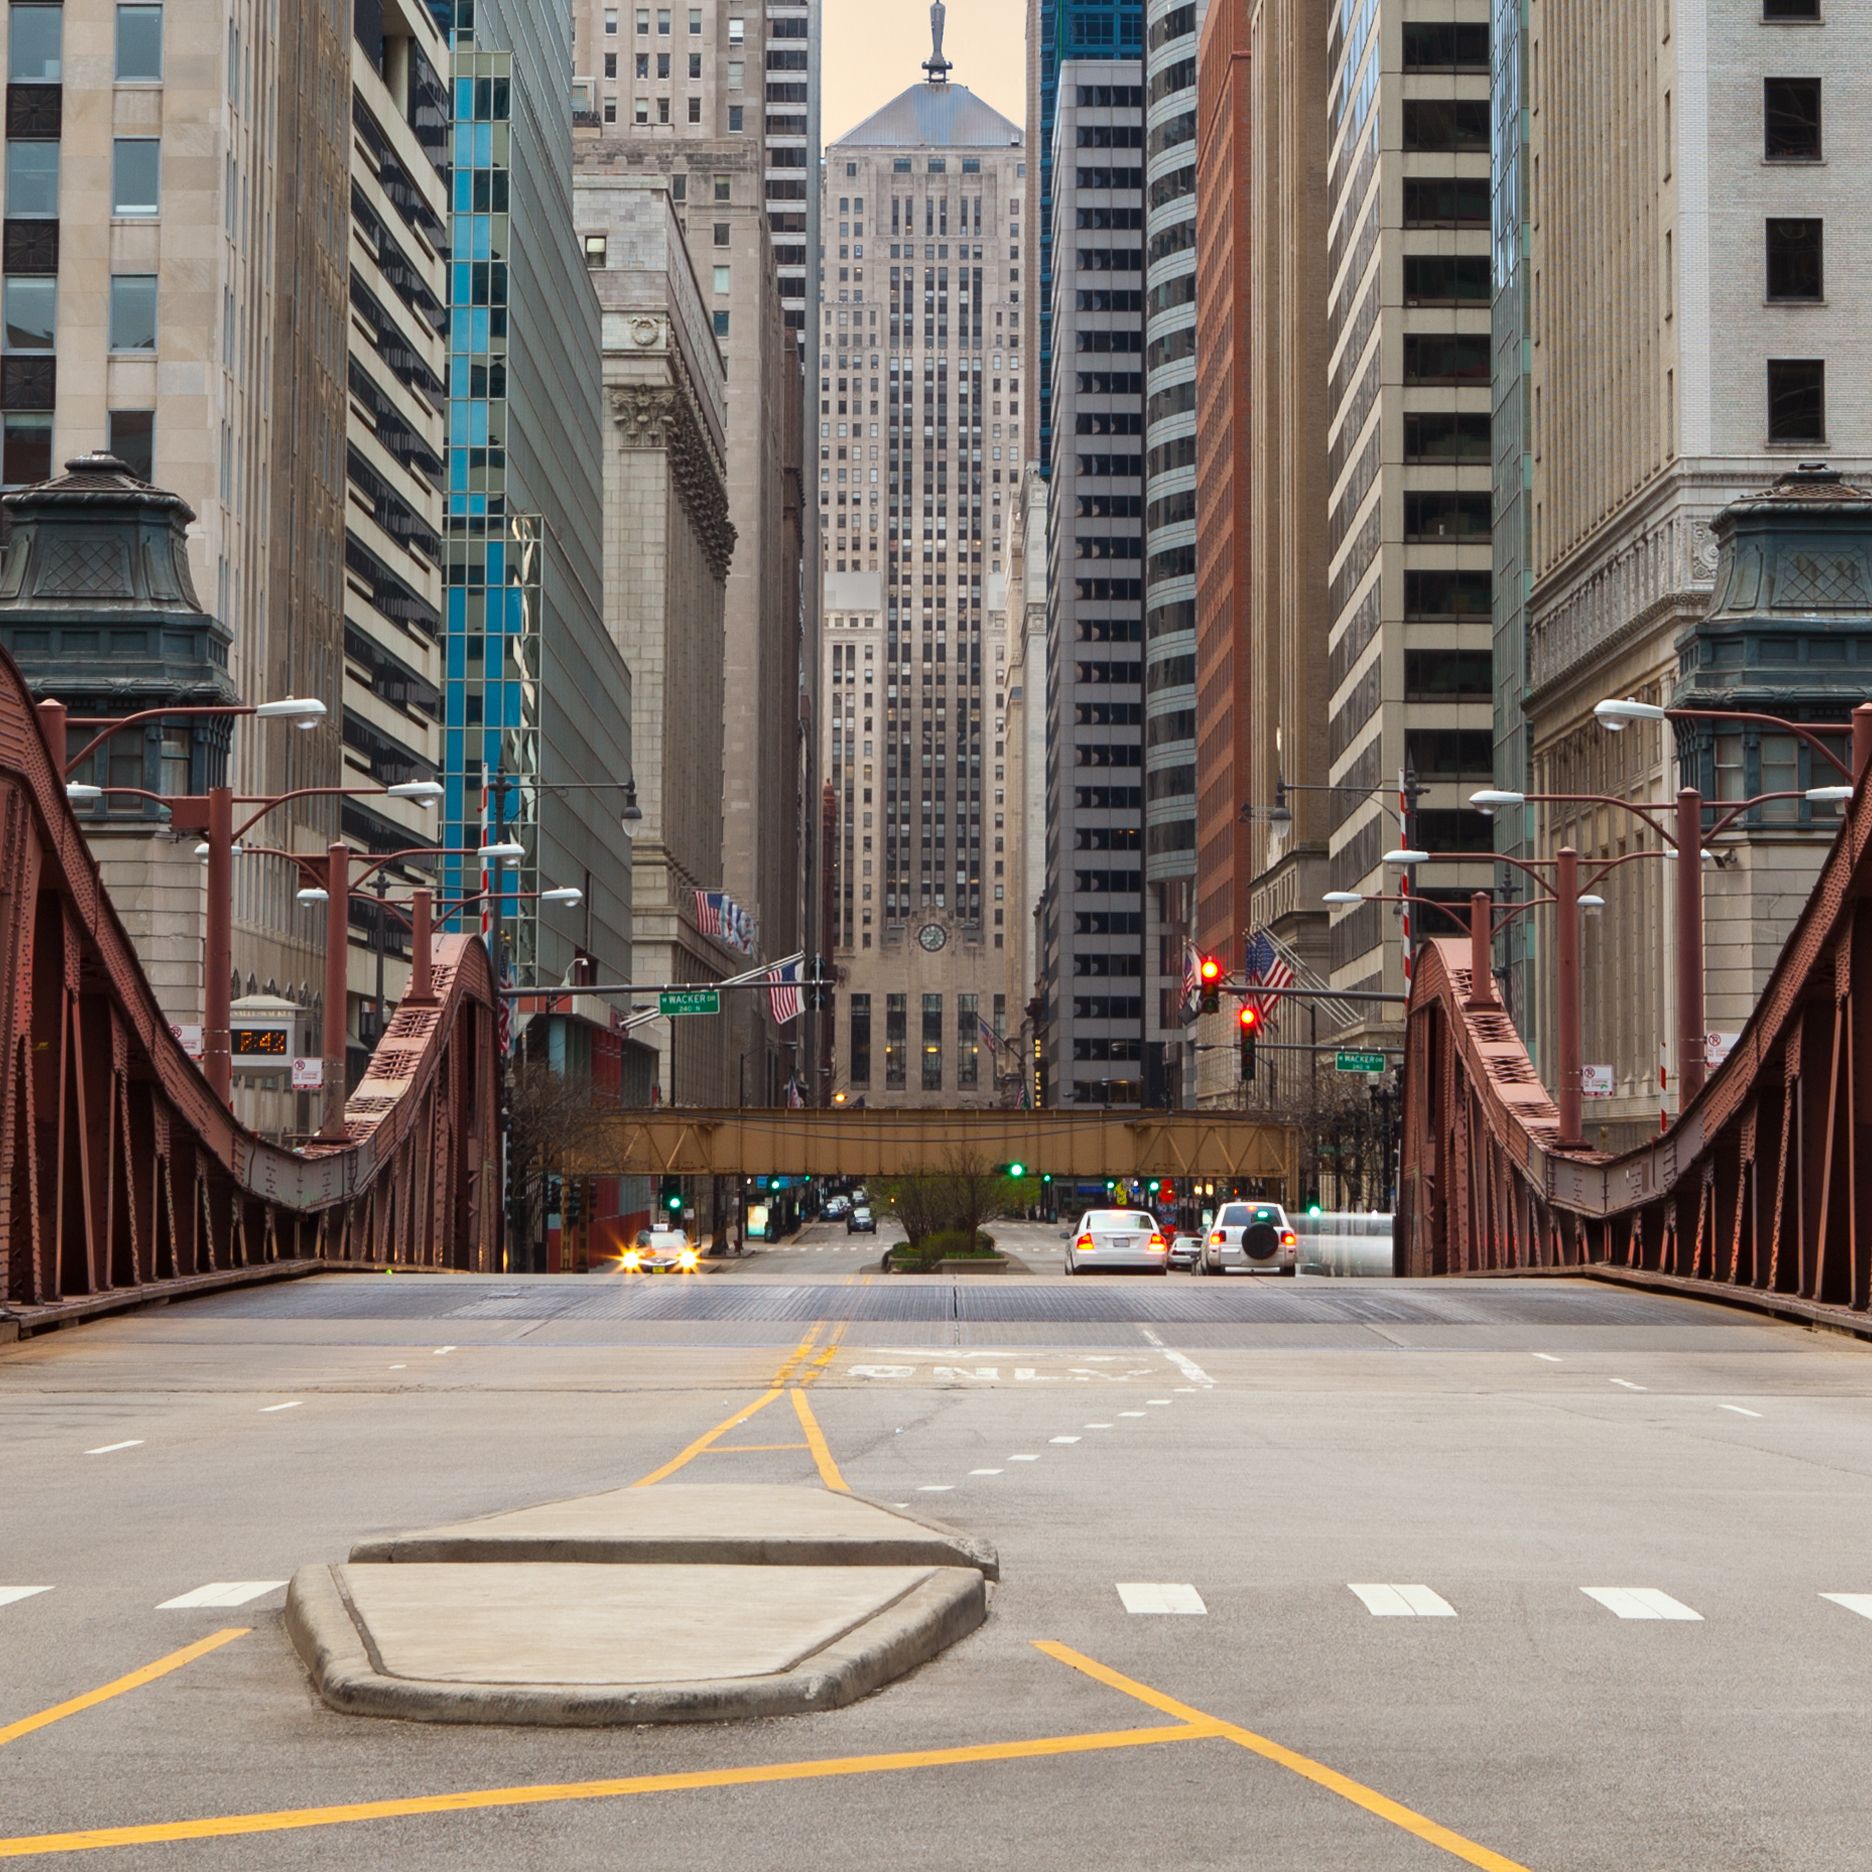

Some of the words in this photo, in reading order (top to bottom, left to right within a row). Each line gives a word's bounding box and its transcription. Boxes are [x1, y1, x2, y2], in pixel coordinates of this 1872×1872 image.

[669, 994, 706, 1004] WACKER
[1344, 1055, 1375, 1064] WACKER
[847, 1364, 1158, 1382] ONLY
